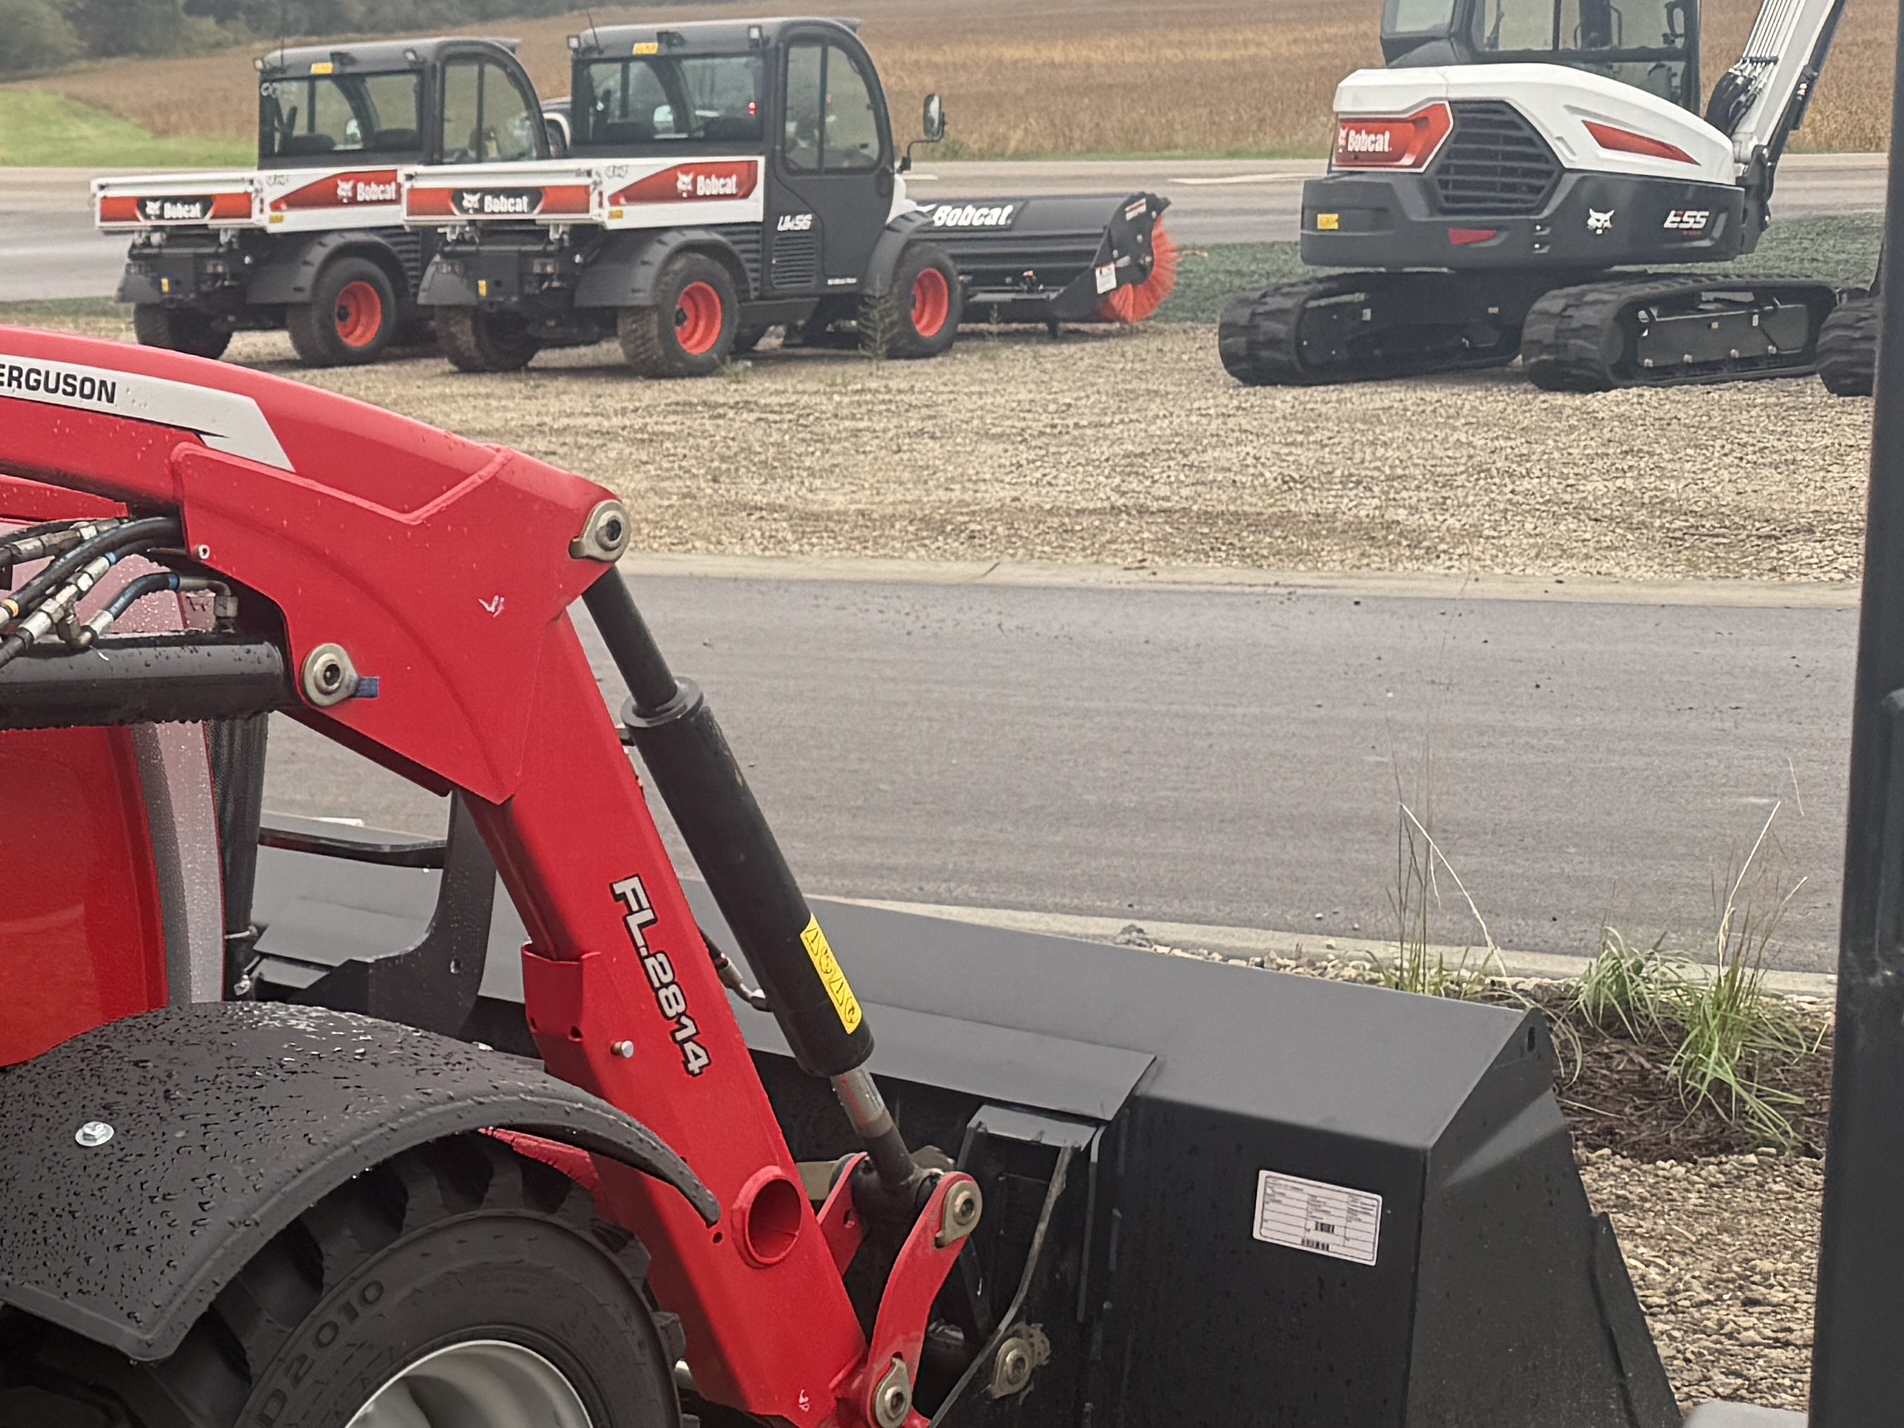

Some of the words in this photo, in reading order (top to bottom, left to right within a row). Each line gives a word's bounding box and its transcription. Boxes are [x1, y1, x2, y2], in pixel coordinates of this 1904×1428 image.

[1348, 129, 1390, 153] Bobcat
[357, 181, 396, 201] Bobcat
[697, 172, 738, 196] Bobcat
[163, 201, 202, 220] Bobcat
[484, 194, 530, 214] Bobcat
[932, 203, 1014, 227] Bobcat
[609, 873, 713, 1078] FL.2814
